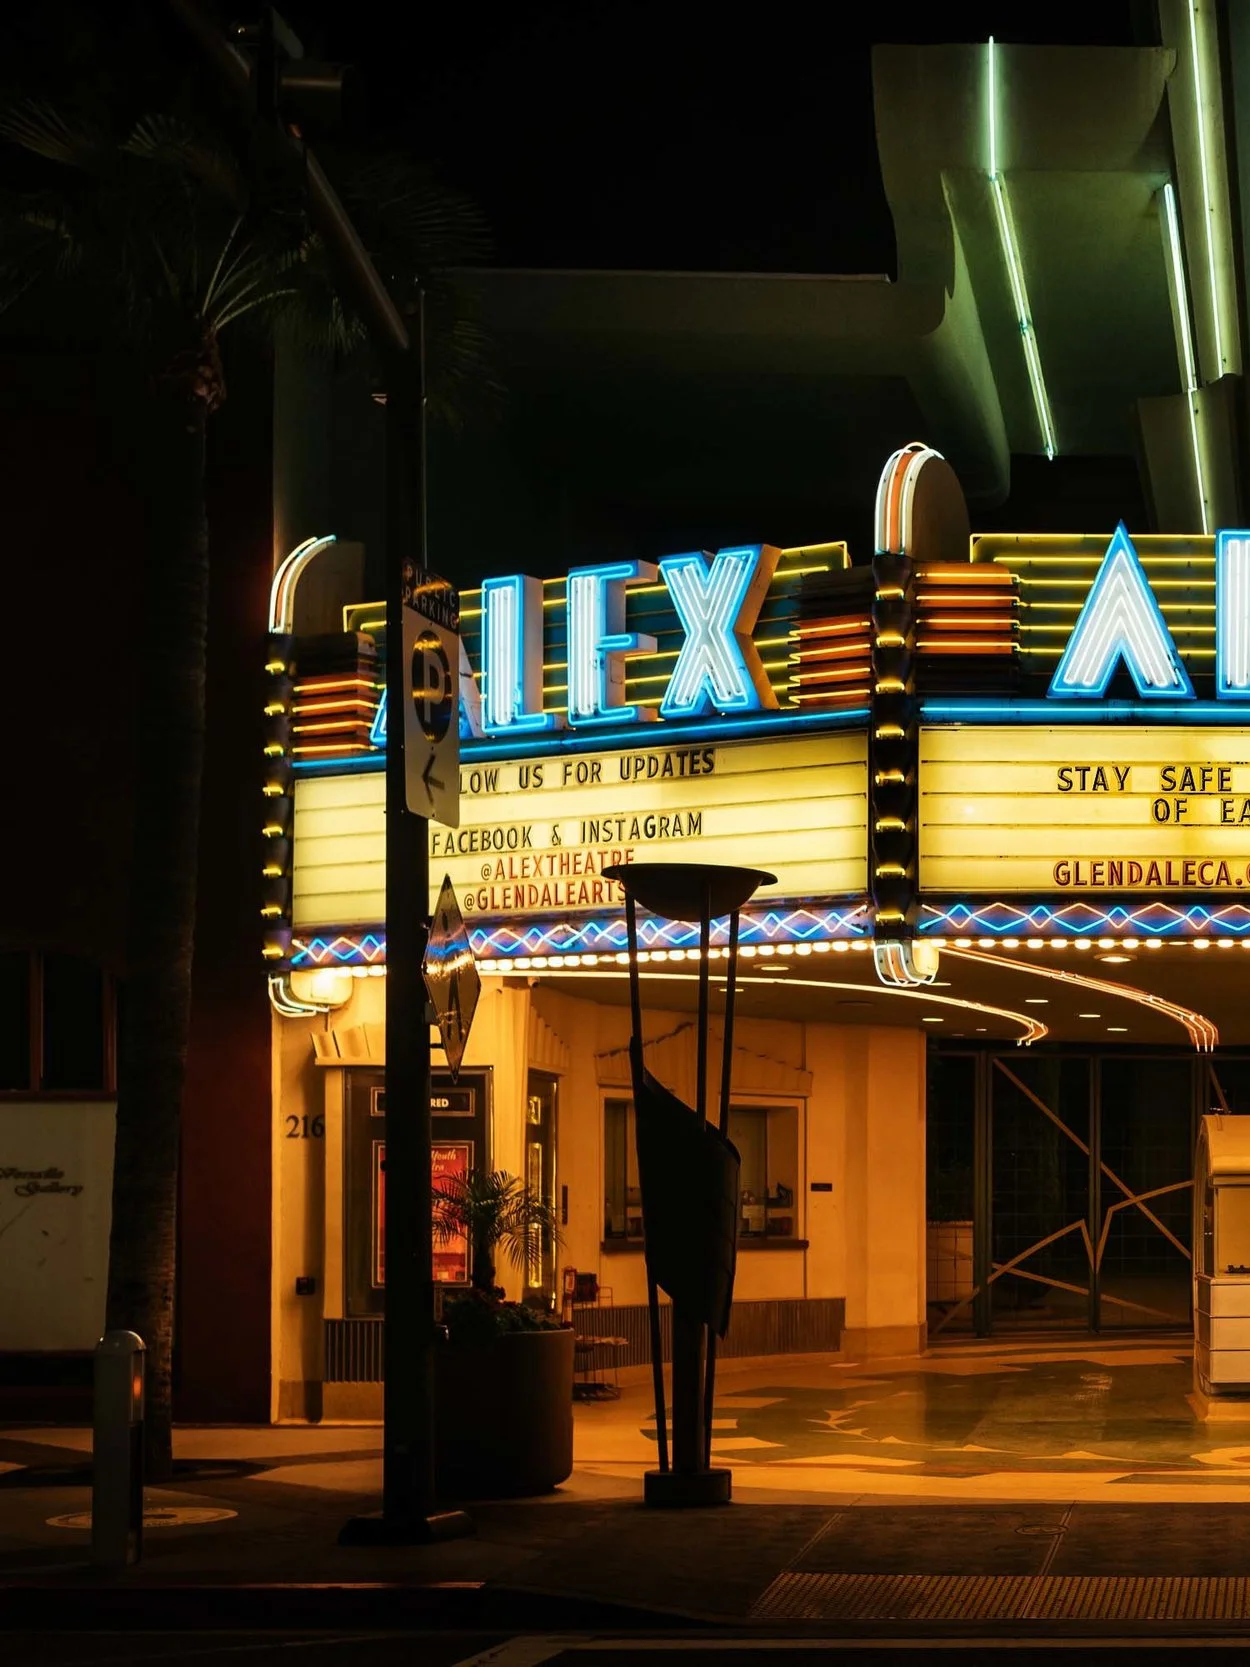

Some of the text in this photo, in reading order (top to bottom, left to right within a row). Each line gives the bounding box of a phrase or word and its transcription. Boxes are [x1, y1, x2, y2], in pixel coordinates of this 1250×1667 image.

[404, 584, 459, 630] PARKING
[370, 543, 780, 748] LEX
[519, 763, 544, 790] US
[563, 761, 602, 786] FOR
[620, 748, 716, 781] UPDATES
[1056, 766, 1132, 794] STAY
[1160, 766, 1233, 794] SAFE
[1152, 798, 1189, 824] OF
[432, 812, 703, 855] FACEBOOK & INSTAGRAM
[481, 848, 635, 880] @ALEXTHEATRE
[464, 879, 626, 912] @GLENDALEARTS
[286, 1114, 326, 1139] 216
